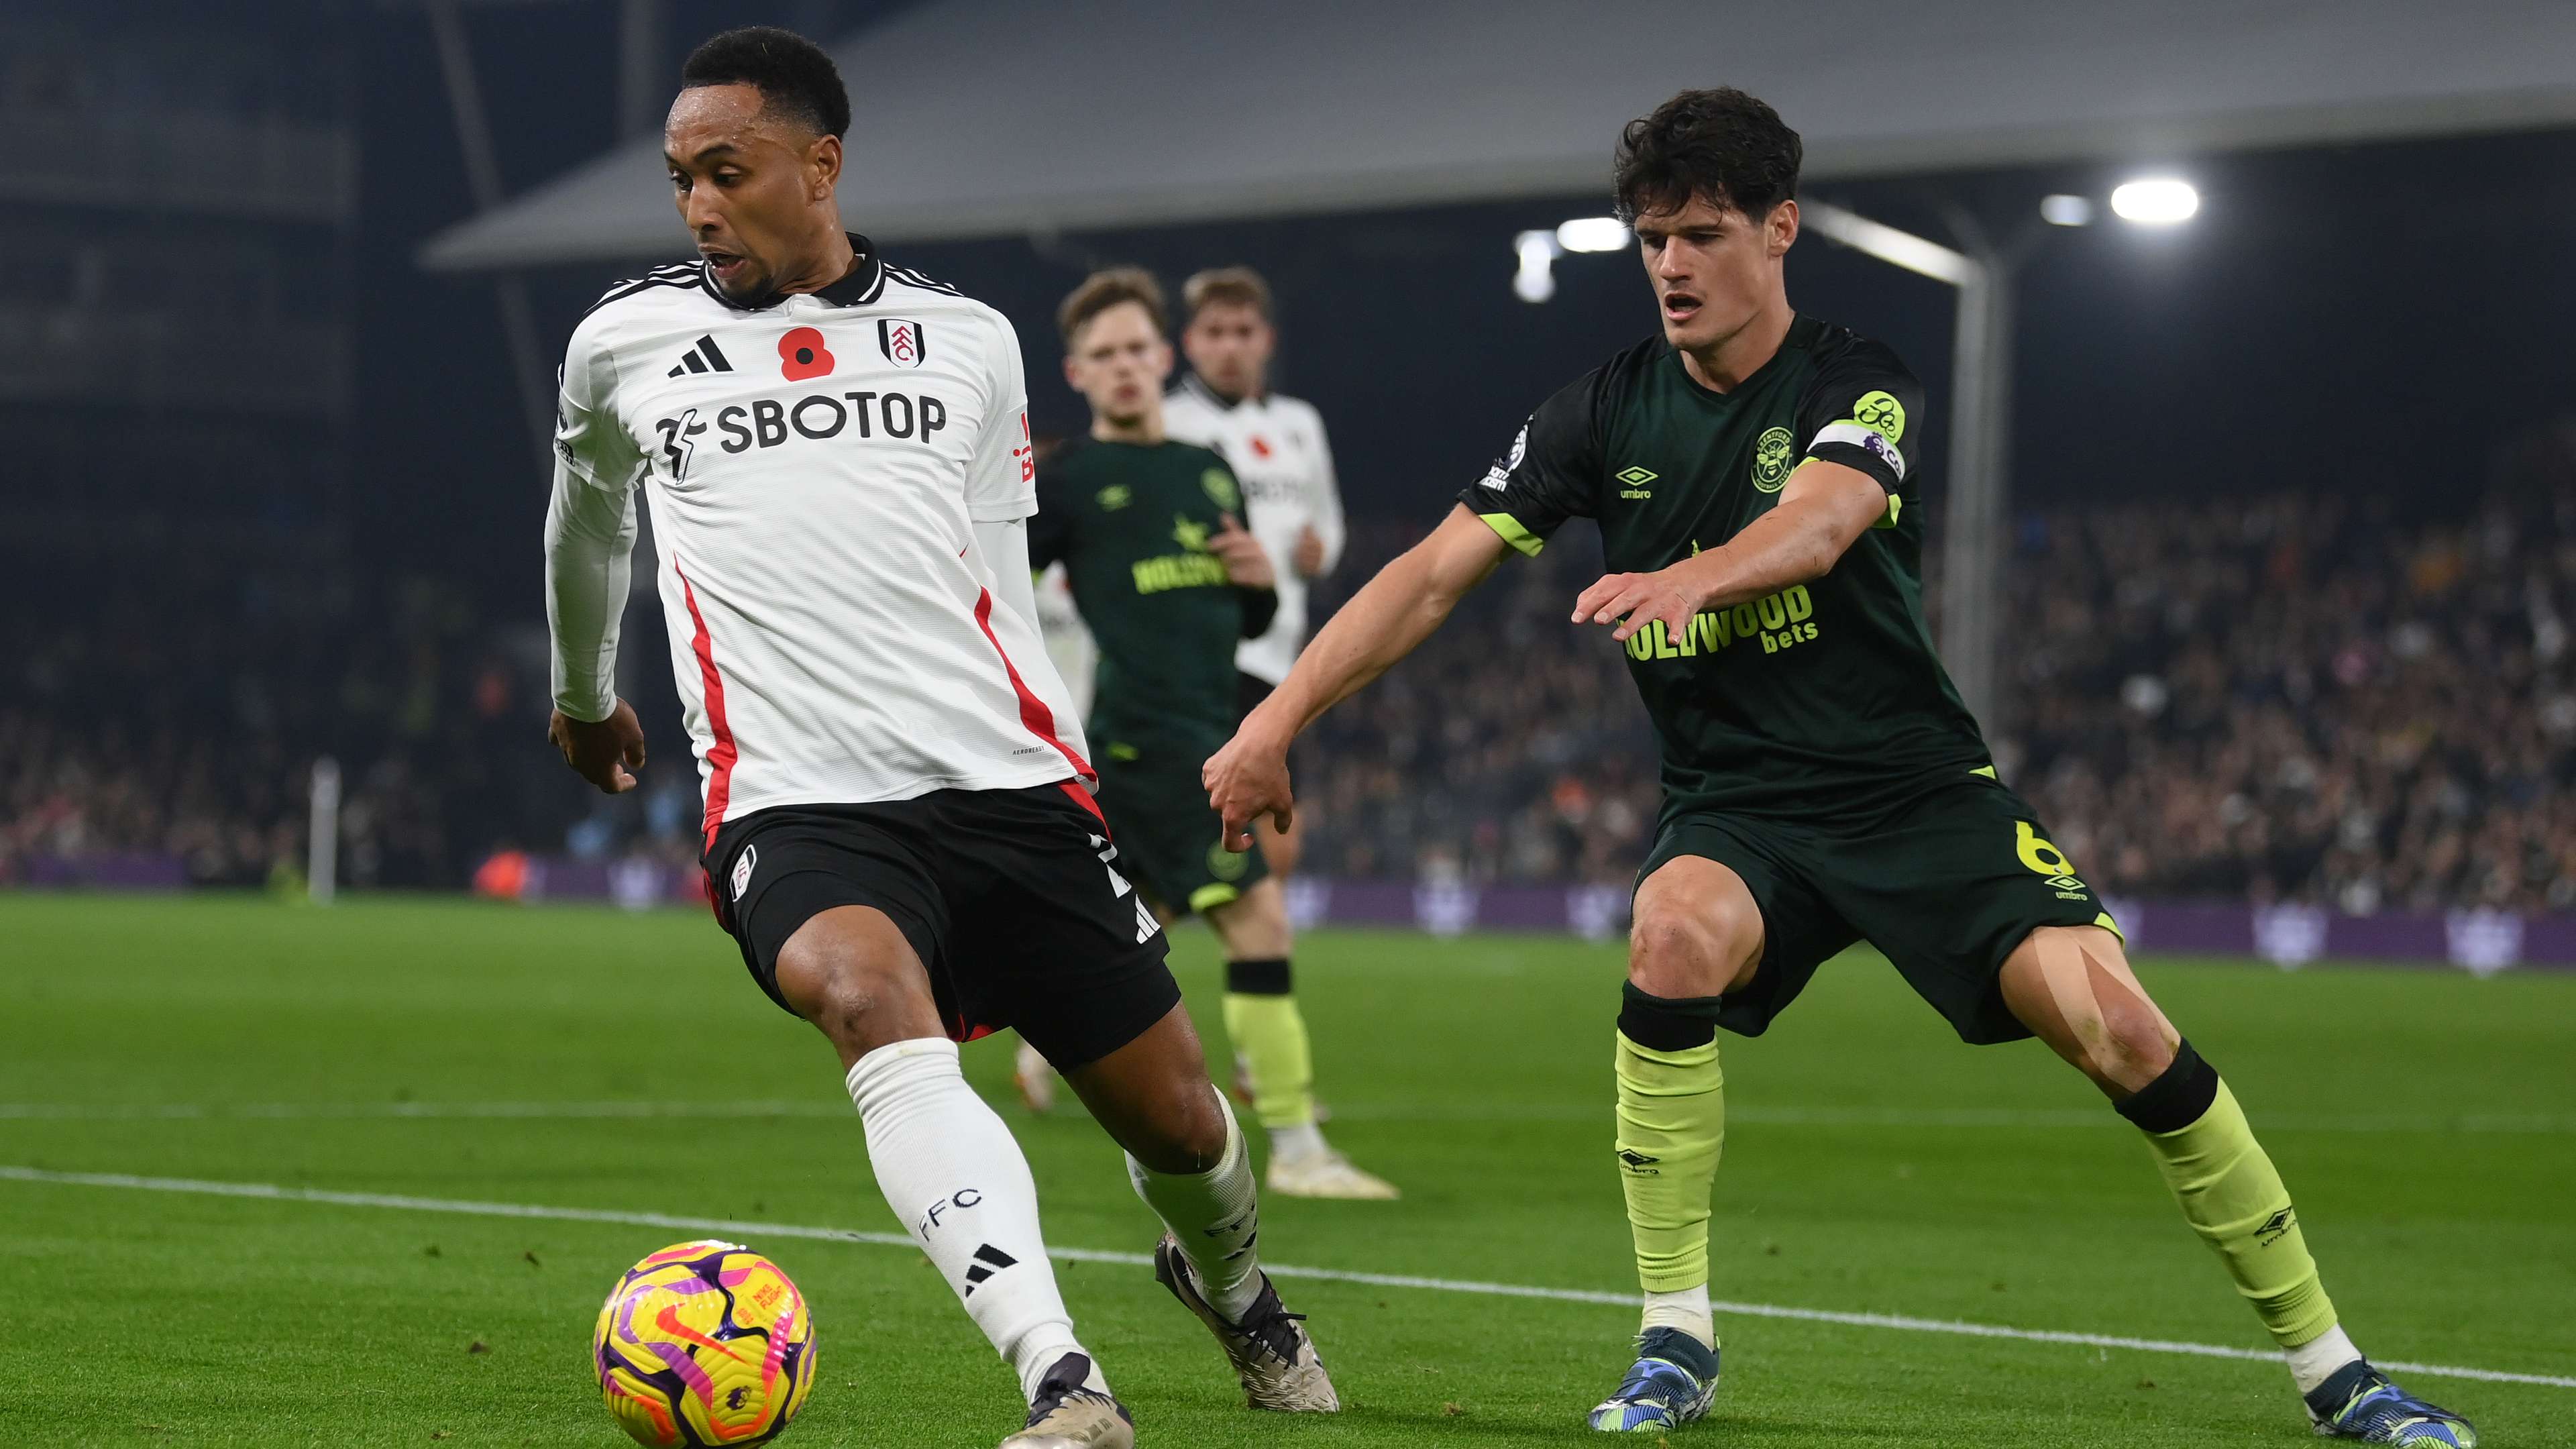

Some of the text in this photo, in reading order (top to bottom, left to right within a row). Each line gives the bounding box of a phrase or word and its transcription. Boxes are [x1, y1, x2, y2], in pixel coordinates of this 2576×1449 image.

[717, 391, 947, 454] SBOTOP
[1620, 488, 1652, 499] umbro
[1759, 622, 1819, 654] bets
[2015, 820, 2076, 876] 6
[2055, 890, 2088, 902] umbro
[918, 1188, 982, 1243] FFC
[752, 1283, 773, 1303] NIKE
